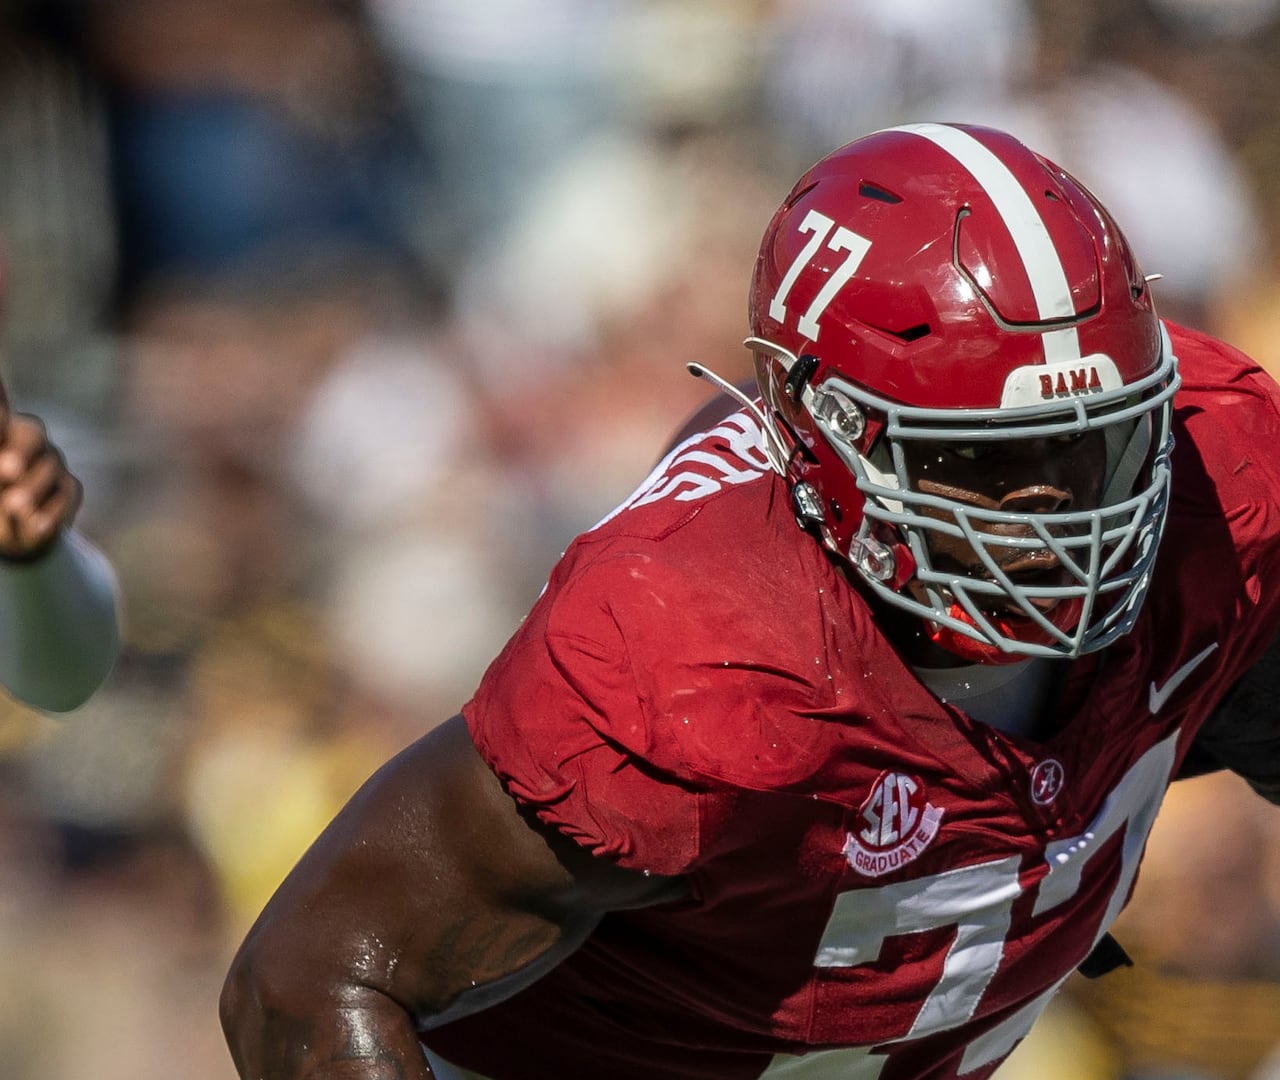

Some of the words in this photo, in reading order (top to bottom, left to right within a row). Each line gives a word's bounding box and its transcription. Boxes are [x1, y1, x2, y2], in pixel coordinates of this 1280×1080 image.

[768, 209, 873, 343] 77
[1038, 366, 1104, 400] BAMA
[861, 771, 918, 846] SEC
[854, 828, 930, 871] GRADUATE
